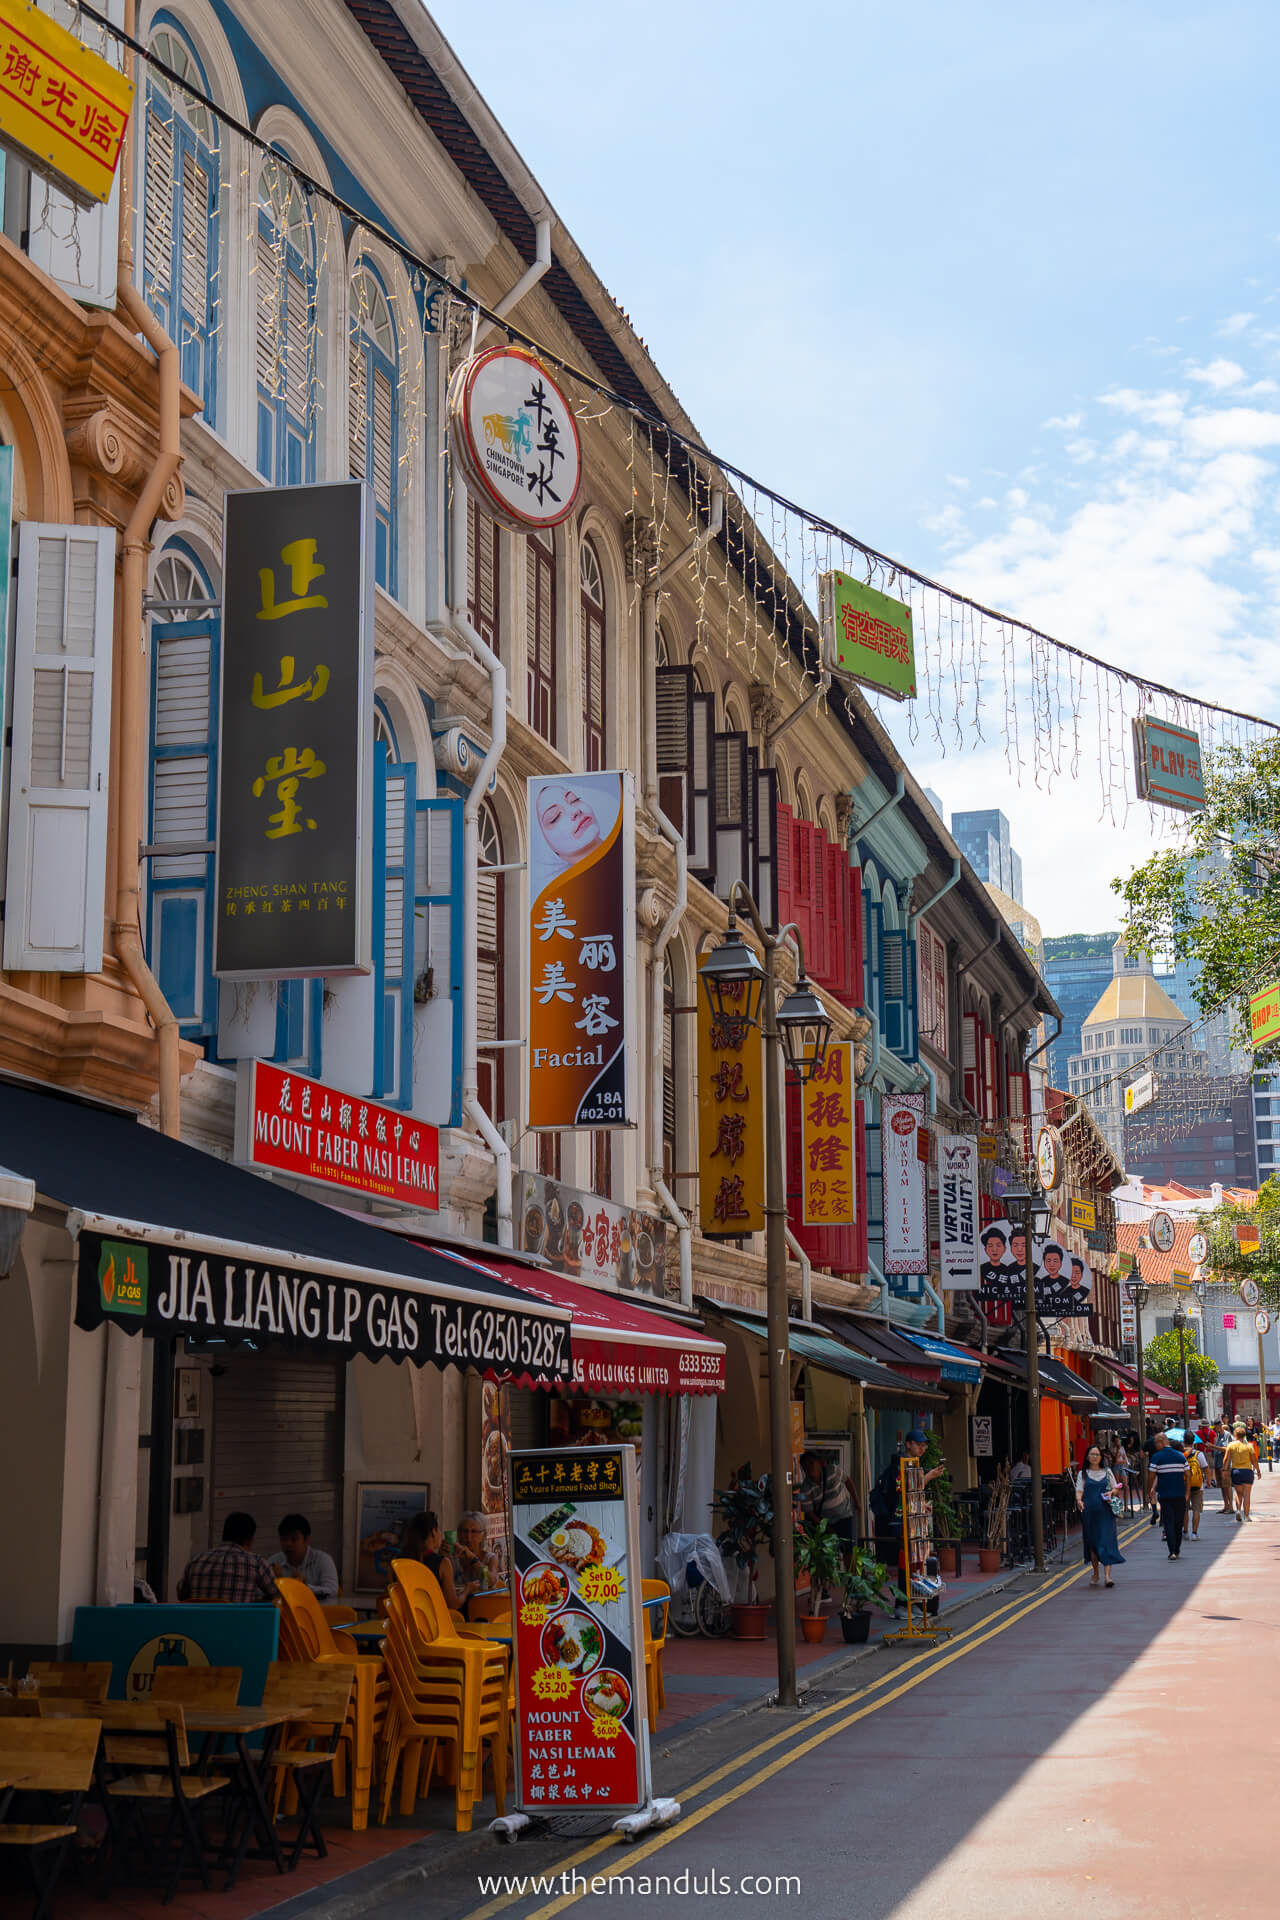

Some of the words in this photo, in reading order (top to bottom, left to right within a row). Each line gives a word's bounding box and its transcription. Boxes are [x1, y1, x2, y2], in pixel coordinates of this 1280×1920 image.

[0, 43, 119, 153] 谢光临
[524, 378, 565, 507] 牛车水
[486, 447, 525, 476] CHINATOWN
[486, 459, 524, 488] SINGAPORE
[251, 537, 331, 840] 正山堂
[1151, 745, 1185, 778] PLAY
[226, 885, 269, 899] ZHENG
[272, 883, 306, 896] SHAN
[311, 880, 347, 894] TANG
[1252, 1005, 1271, 1030] SHOP
[533, 1044, 604, 1069] Facial
[595, 1093, 622, 1105] 18A
[580, 1107, 623, 1120] #02-01
[255, 1110, 313, 1157] MOUNT
[317, 1129, 359, 1170] FABER
[363, 1144, 393, 1181] NASI
[397, 1155, 437, 1193] LEMAK
[947, 1162, 970, 1170] WORLD
[943, 1173, 957, 1243] VIRTUAL
[960, 1173, 973, 1246] REALITY
[1073, 1206, 1089, 1219] EAT
[123, 1257, 139, 1285] JL
[127, 1286, 142, 1299] GAS
[157, 1254, 217, 1326] JIA
[223, 1264, 321, 1340] LIANG
[326, 1284, 362, 1343] LP
[367, 1292, 419, 1351] GAS
[679, 1353, 700, 1373] 6333
[700, 1355, 721, 1375] 5555
[776, 1349, 785, 1366] 7
[588, 1362, 635, 1384] HOLDINGS
[638, 1366, 669, 1385] LIMITED
[529, 1484, 550, 1495] Years
[550, 1484, 578, 1493] Famous
[579, 1482, 597, 1491] Food
[599, 1481, 617, 1491] Shop
[589, 1571, 603, 1582] Set
[605, 1571, 613, 1581] D
[584, 1583, 619, 1598] $7.00
[524, 1613, 544, 1622] $4.20
[543, 1671, 554, 1680] Set
[556, 1671, 562, 1680] B
[538, 1682, 567, 1694] $5.20
[528, 1710, 580, 1724] MOUNT
[528, 1729, 572, 1742] FABER
[597, 1726, 617, 1736] $6.00
[529, 1747, 563, 1760] NASI
[567, 1746, 616, 1760] LEMAK
